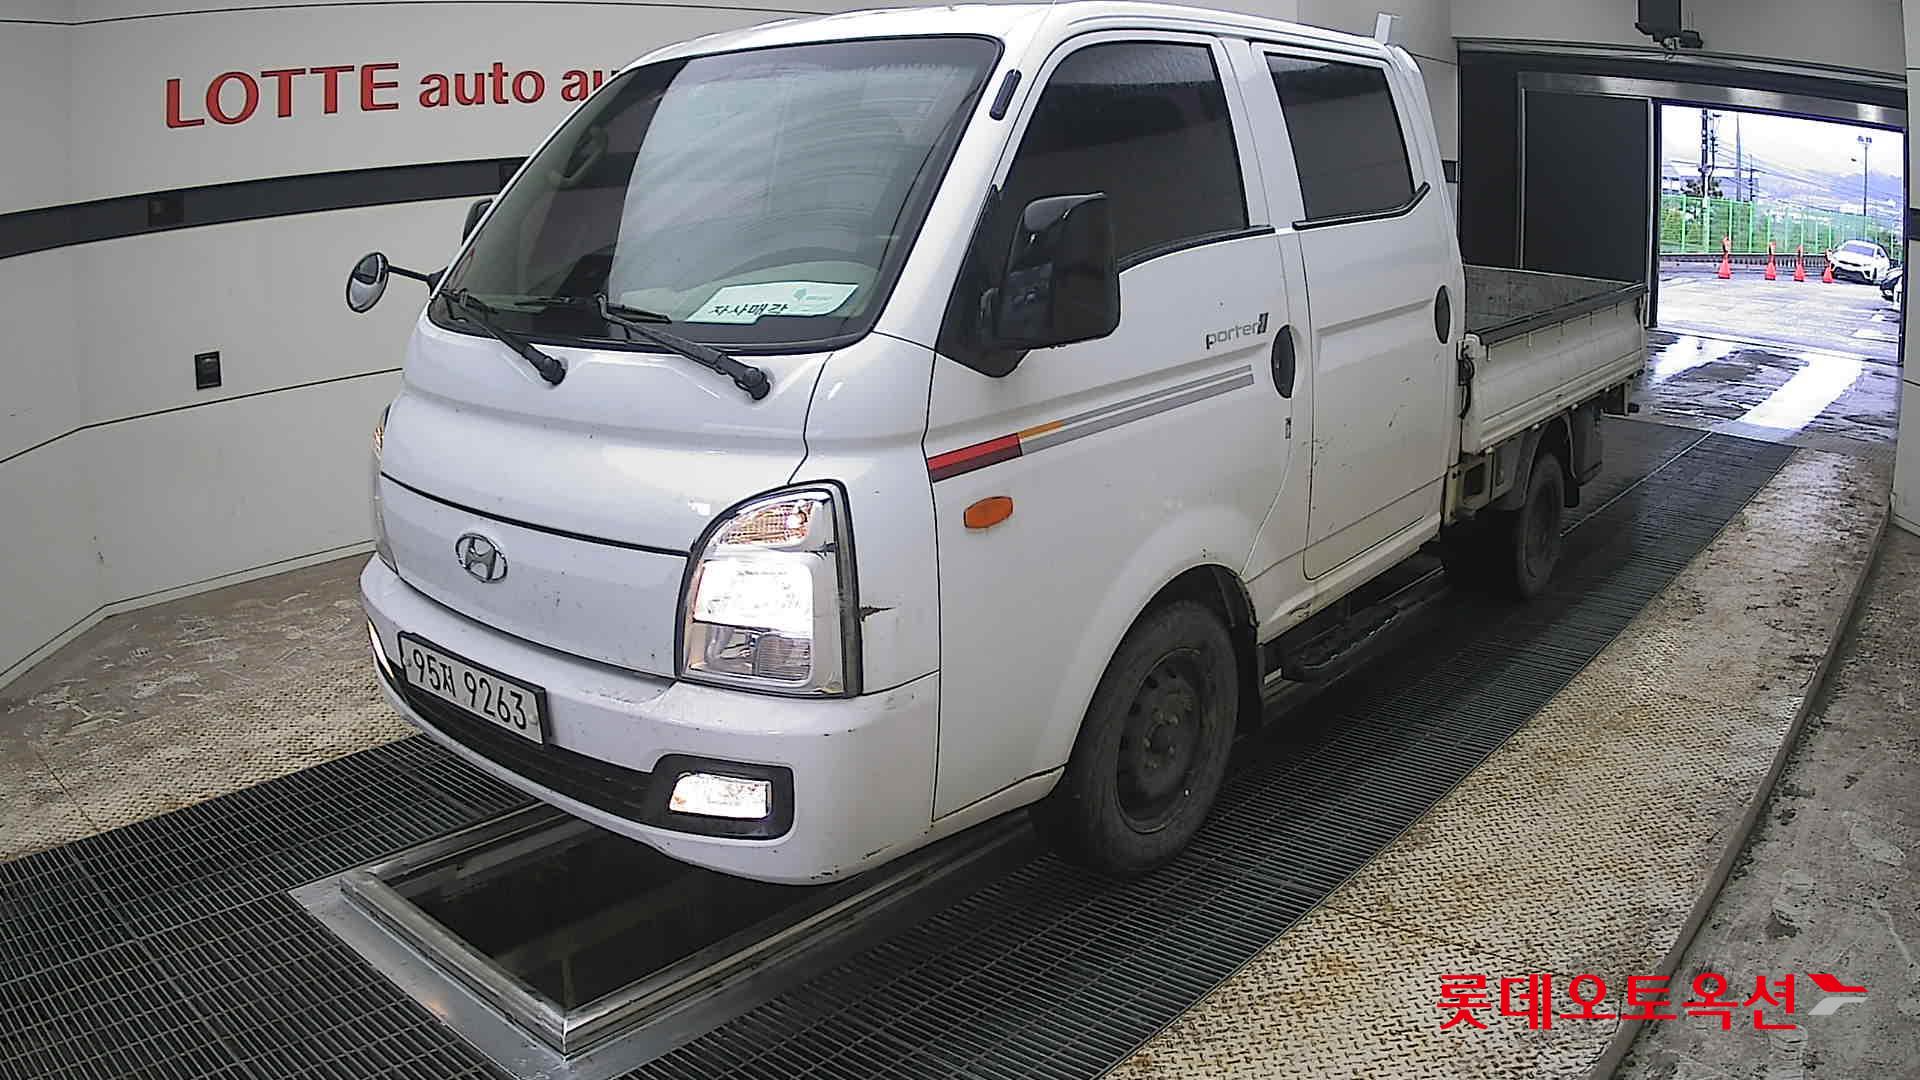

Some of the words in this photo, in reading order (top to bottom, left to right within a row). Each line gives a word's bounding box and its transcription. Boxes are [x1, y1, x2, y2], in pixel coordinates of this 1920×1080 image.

[166, 62, 399, 129] LOTTE
[419, 61, 545, 108] auto
[463, 671, 527, 730] 9263
